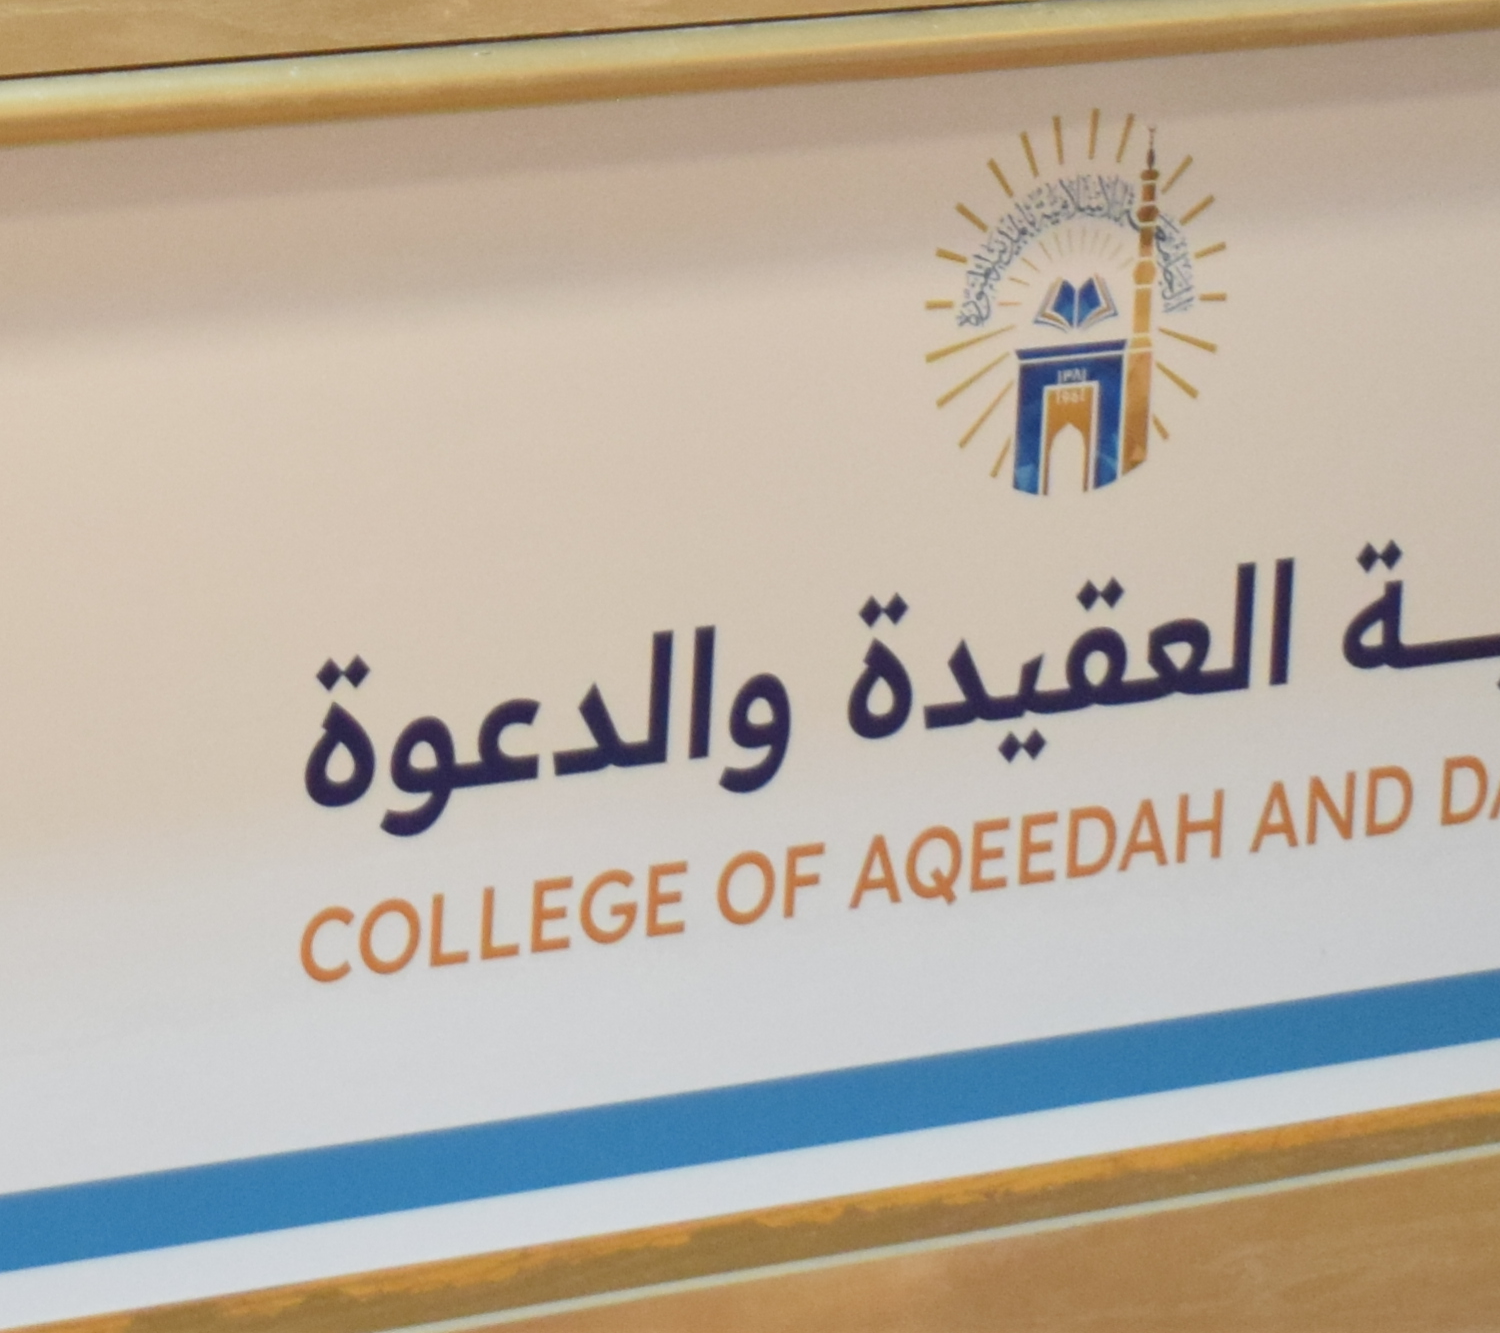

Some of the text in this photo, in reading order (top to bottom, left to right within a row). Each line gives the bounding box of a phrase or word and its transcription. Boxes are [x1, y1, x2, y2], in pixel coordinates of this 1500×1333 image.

[305, 626, 791, 837] والدعوة
[848, 558, 1294, 762] العقيدة
[300, 861, 688, 984] COLLEGE
[717, 843, 825, 925] OF
[850, 789, 1224, 909] AQEEDAH
[1250, 766, 1413, 853] AND
